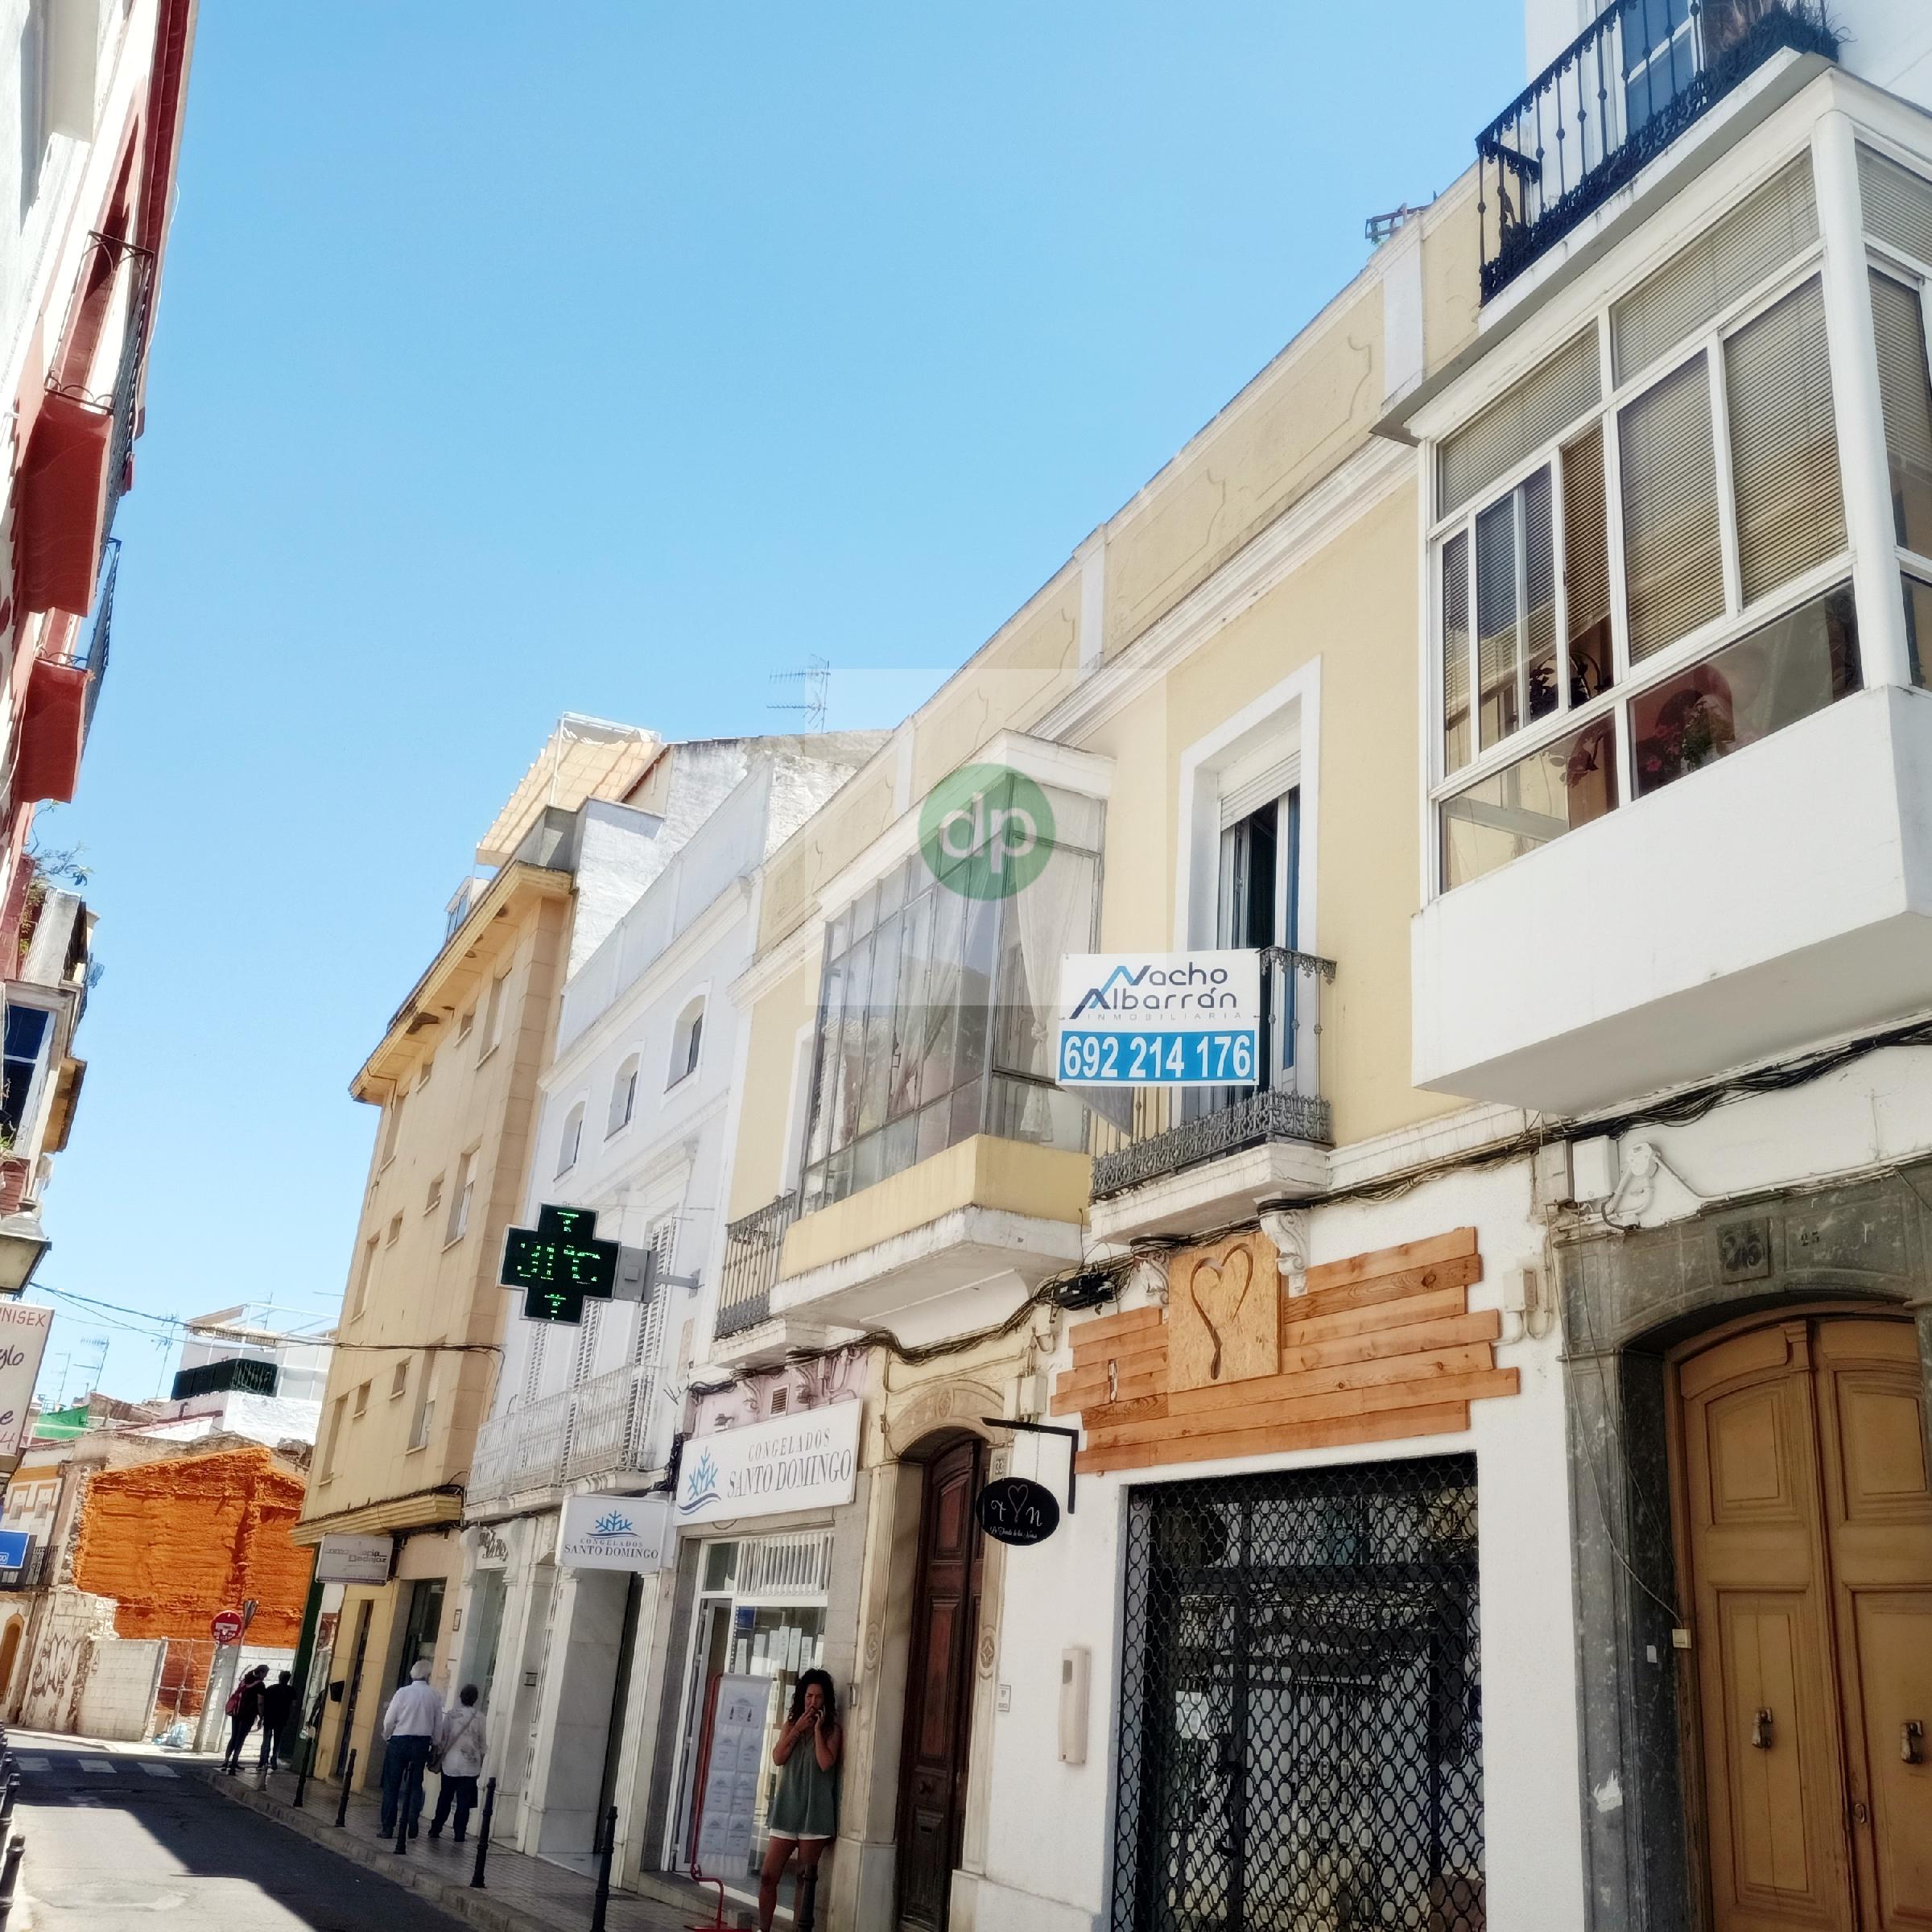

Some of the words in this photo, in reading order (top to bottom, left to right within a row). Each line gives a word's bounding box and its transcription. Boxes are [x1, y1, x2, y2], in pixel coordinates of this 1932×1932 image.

[1098, 962, 1228, 987] Nacho
[1069, 987, 1237, 1019] Albarrán
[1088, 1012, 1242, 1022] INMOBILIARIA
[1064, 1035, 1119, 1079] 692
[1129, 1035, 1185, 1079] 214
[1196, 1034, 1251, 1079] 176
[748, 1427, 831, 1463] CONGELADOS
[727, 1463, 774, 1499] SANTO
[775, 1448, 852, 1492] DOMINGO
[564, 1545, 603, 1555] SANTO
[605, 1546, 659, 1559] DOMINGO
[580, 1538, 643, 1547] CONGELADOS
